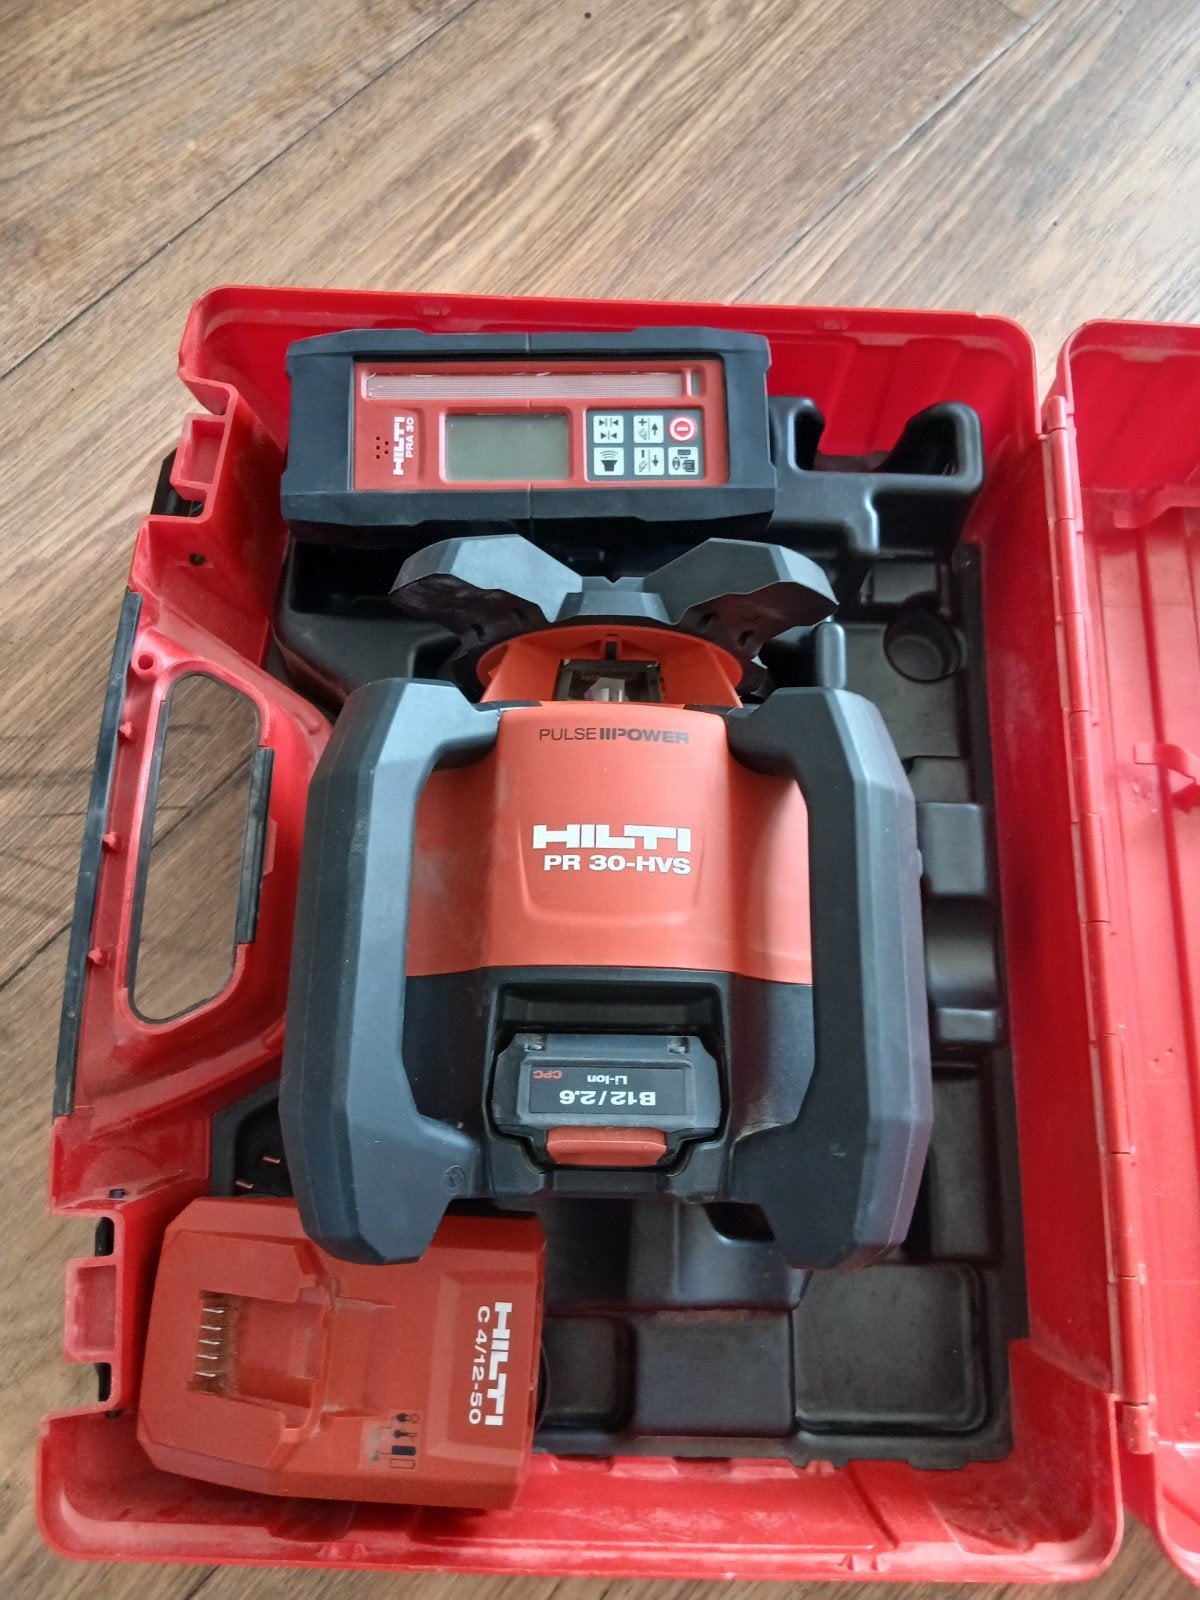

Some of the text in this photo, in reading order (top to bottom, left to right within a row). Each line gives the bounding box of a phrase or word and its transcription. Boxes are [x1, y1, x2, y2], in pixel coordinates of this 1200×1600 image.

[393, 416, 405, 475] HILTI
[405, 417, 415, 459] PRA 30
[539, 727, 597, 741] PULSE
[533, 824, 692, 853] HILTI
[544, 854, 692, 875] PR 30-HVS
[533, 1070, 562, 1079] CPC
[587, 1074, 628, 1085] Li-Ion
[468, 1305, 491, 1425] C 4/12-50
[485, 1301, 513, 1426] HILTI
